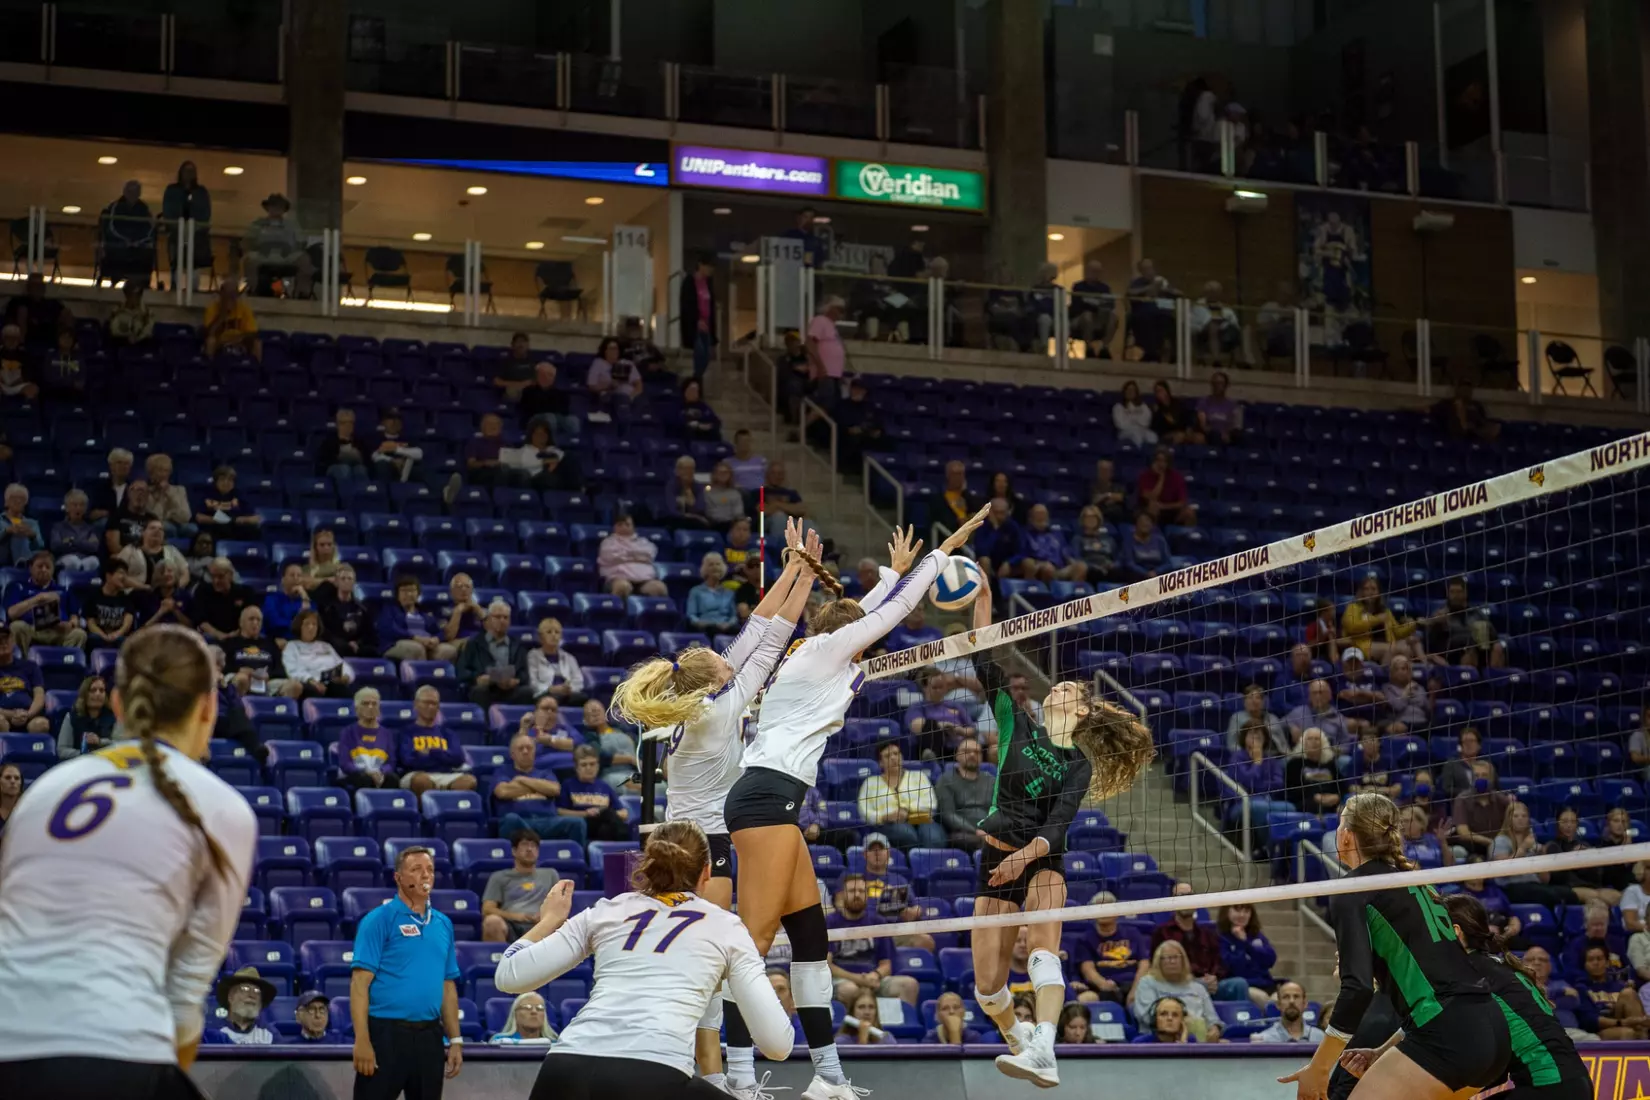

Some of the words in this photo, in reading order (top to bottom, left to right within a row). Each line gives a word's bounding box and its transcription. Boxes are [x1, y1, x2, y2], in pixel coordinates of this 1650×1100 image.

[681, 157, 823, 184] UNIPanthers.com
[859, 164, 960, 200] Veridian
[615, 230, 646, 248] 114
[772, 244, 802, 261] 115
[1350, 495, 1437, 539] NORTHERN
[1443, 481, 1488, 513] IOWA
[1159, 557, 1229, 595] NORTHERN
[1233, 546, 1270, 574] IOWA
[1001, 609, 1058, 638] NORTHERN
[1062, 597, 1093, 622] IOWA
[868, 649, 917, 675] NORTHERN
[920, 639, 945, 661] IOWA
[412, 735, 448, 752] UNI
[48, 775, 133, 841] 6
[621, 908, 707, 953] 17
[1408, 884, 1457, 943] 16
